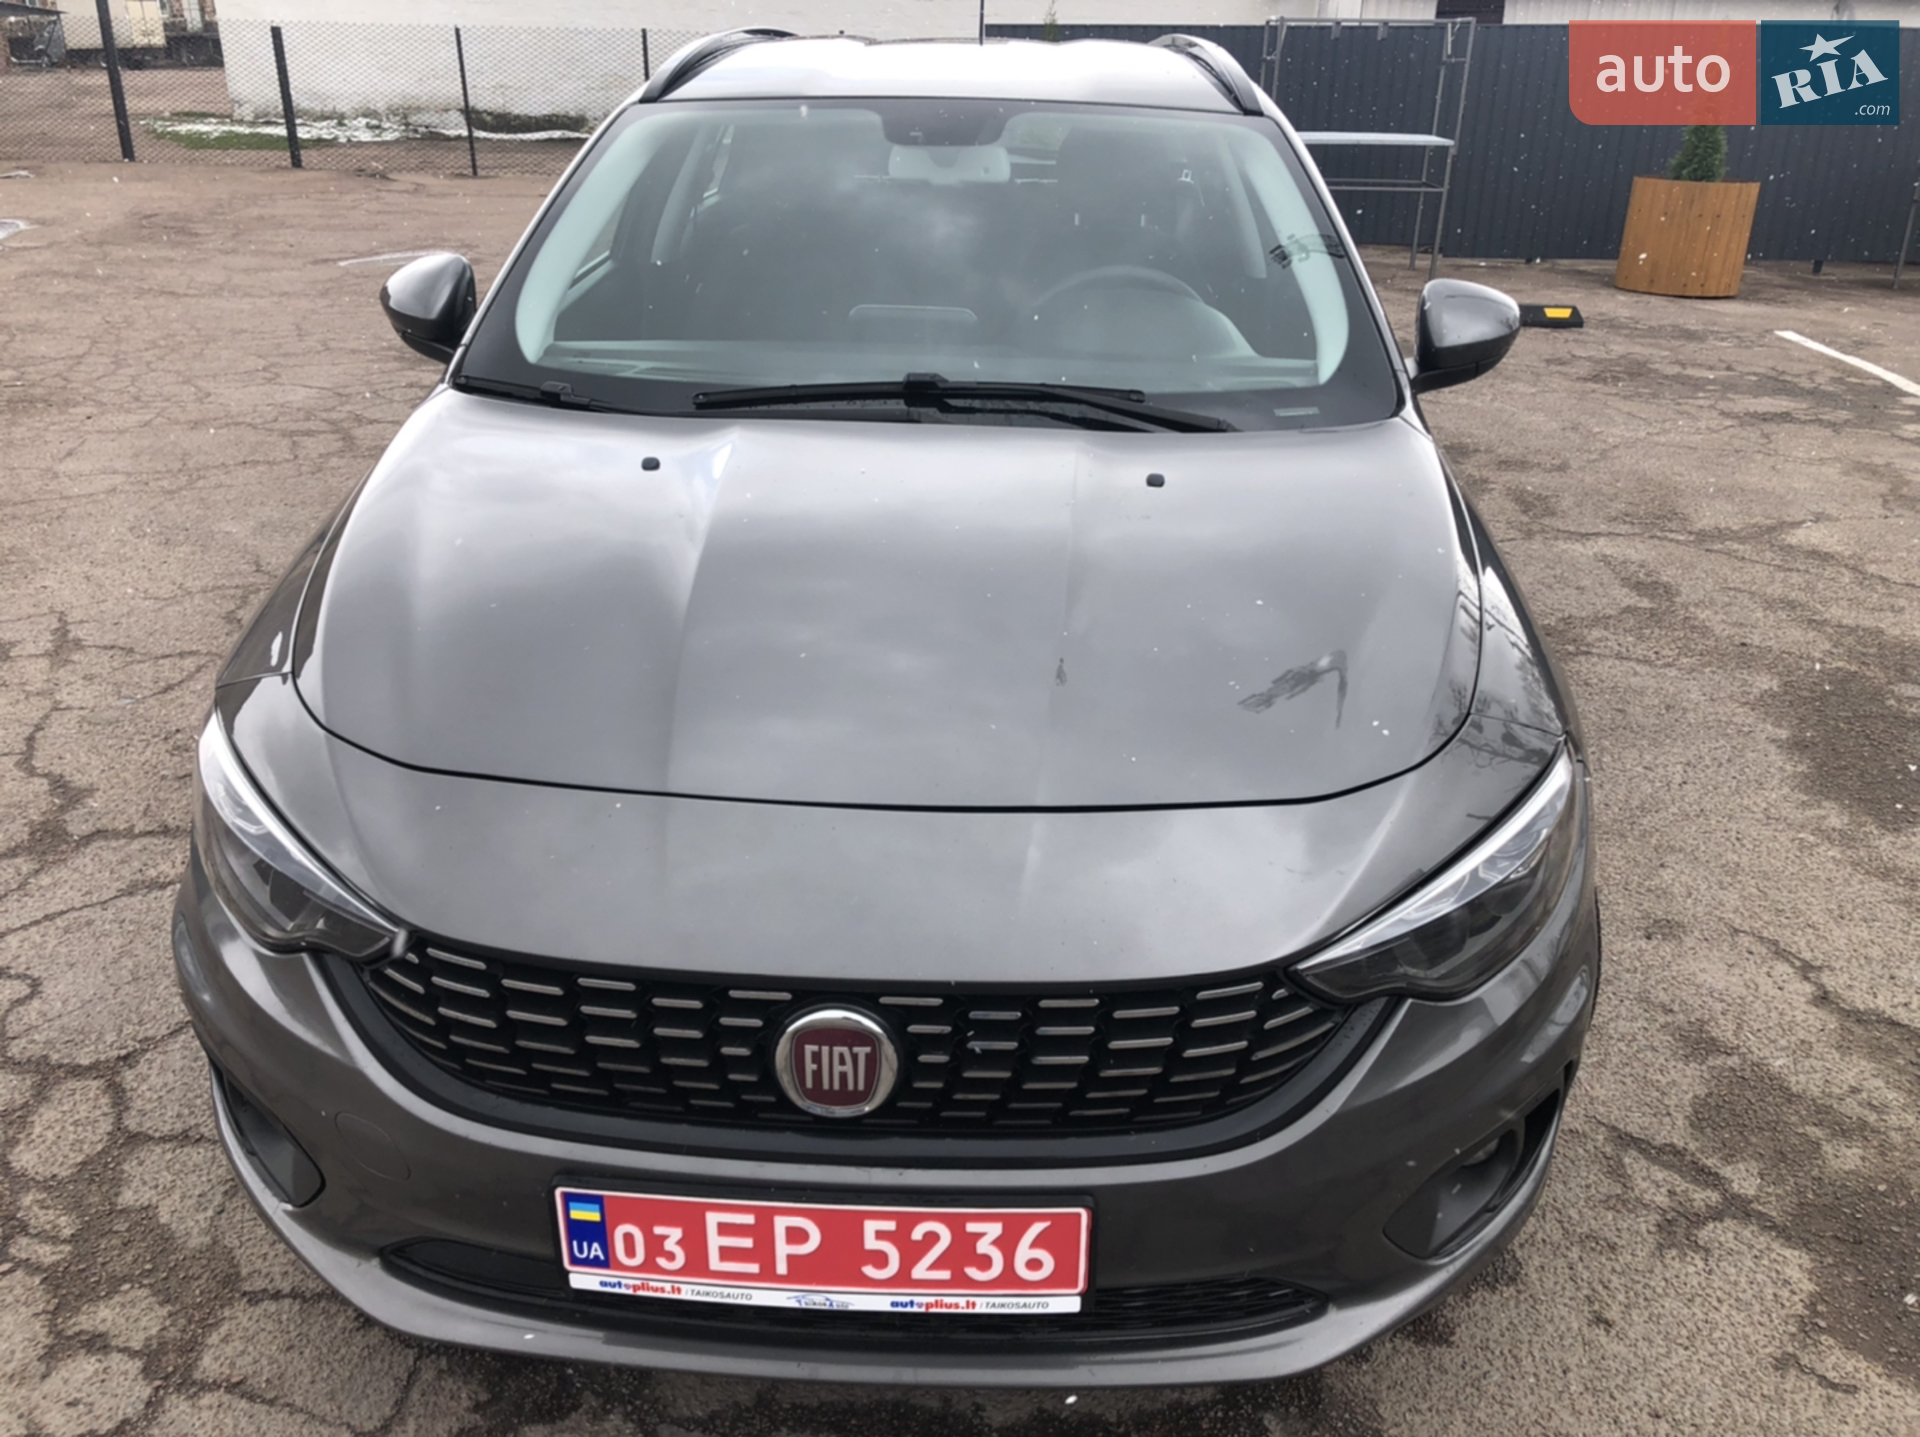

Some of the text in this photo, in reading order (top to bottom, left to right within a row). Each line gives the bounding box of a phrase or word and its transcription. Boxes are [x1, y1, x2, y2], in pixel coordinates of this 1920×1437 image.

[804, 1044, 872, 1091] FIAT
[572, 1240, 605, 1261] UA
[613, 1211, 1056, 1282] 03 EP 5236
[599, 1279, 753, 1301] autoplius.lt TAIKOSAUTO
[890, 1299, 1050, 1312] autoplius.lt TAIKOSAUTO
